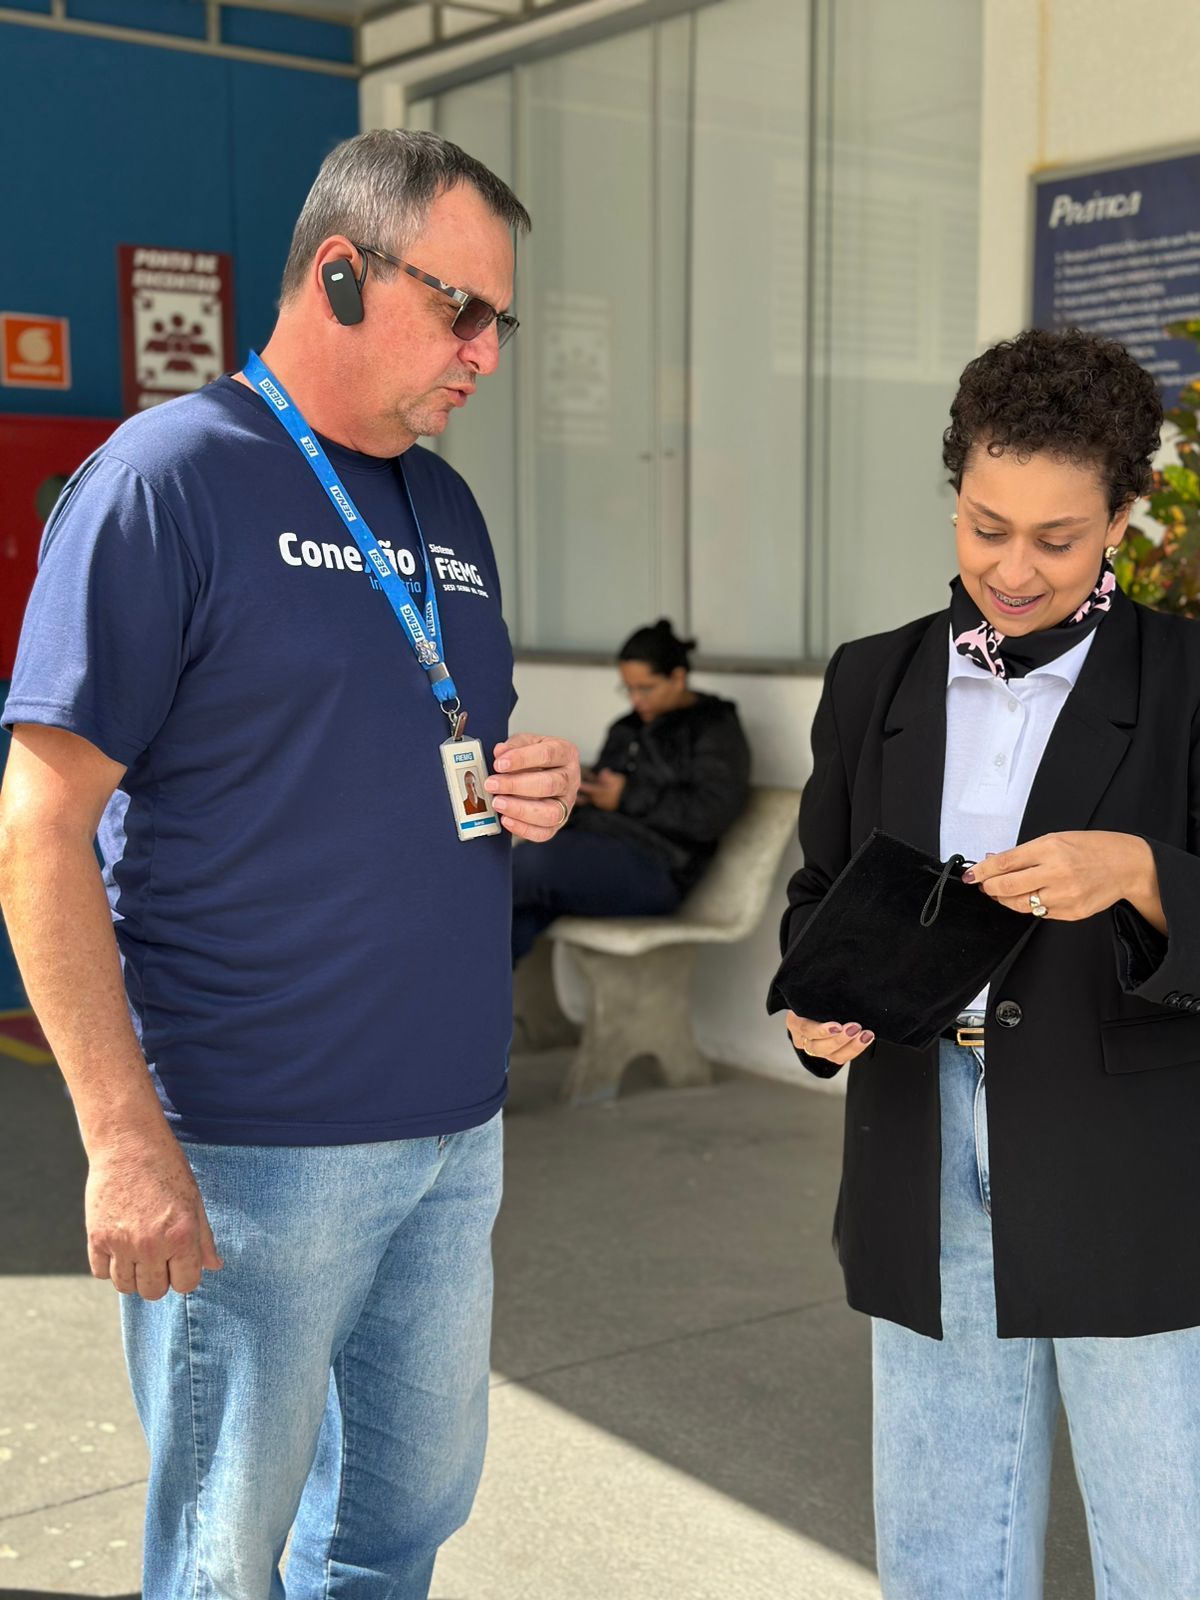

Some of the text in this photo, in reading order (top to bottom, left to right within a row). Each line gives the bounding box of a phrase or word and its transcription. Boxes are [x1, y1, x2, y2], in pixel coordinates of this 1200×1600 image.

[261, 381, 286, 407] CIEMG
[303, 438, 317, 454] IEL
[332, 488, 354, 518] SENAI
[279, 532, 416, 575] Coneão
[370, 552, 389, 574] SESI
[402, 607, 424, 639] FIEMG
